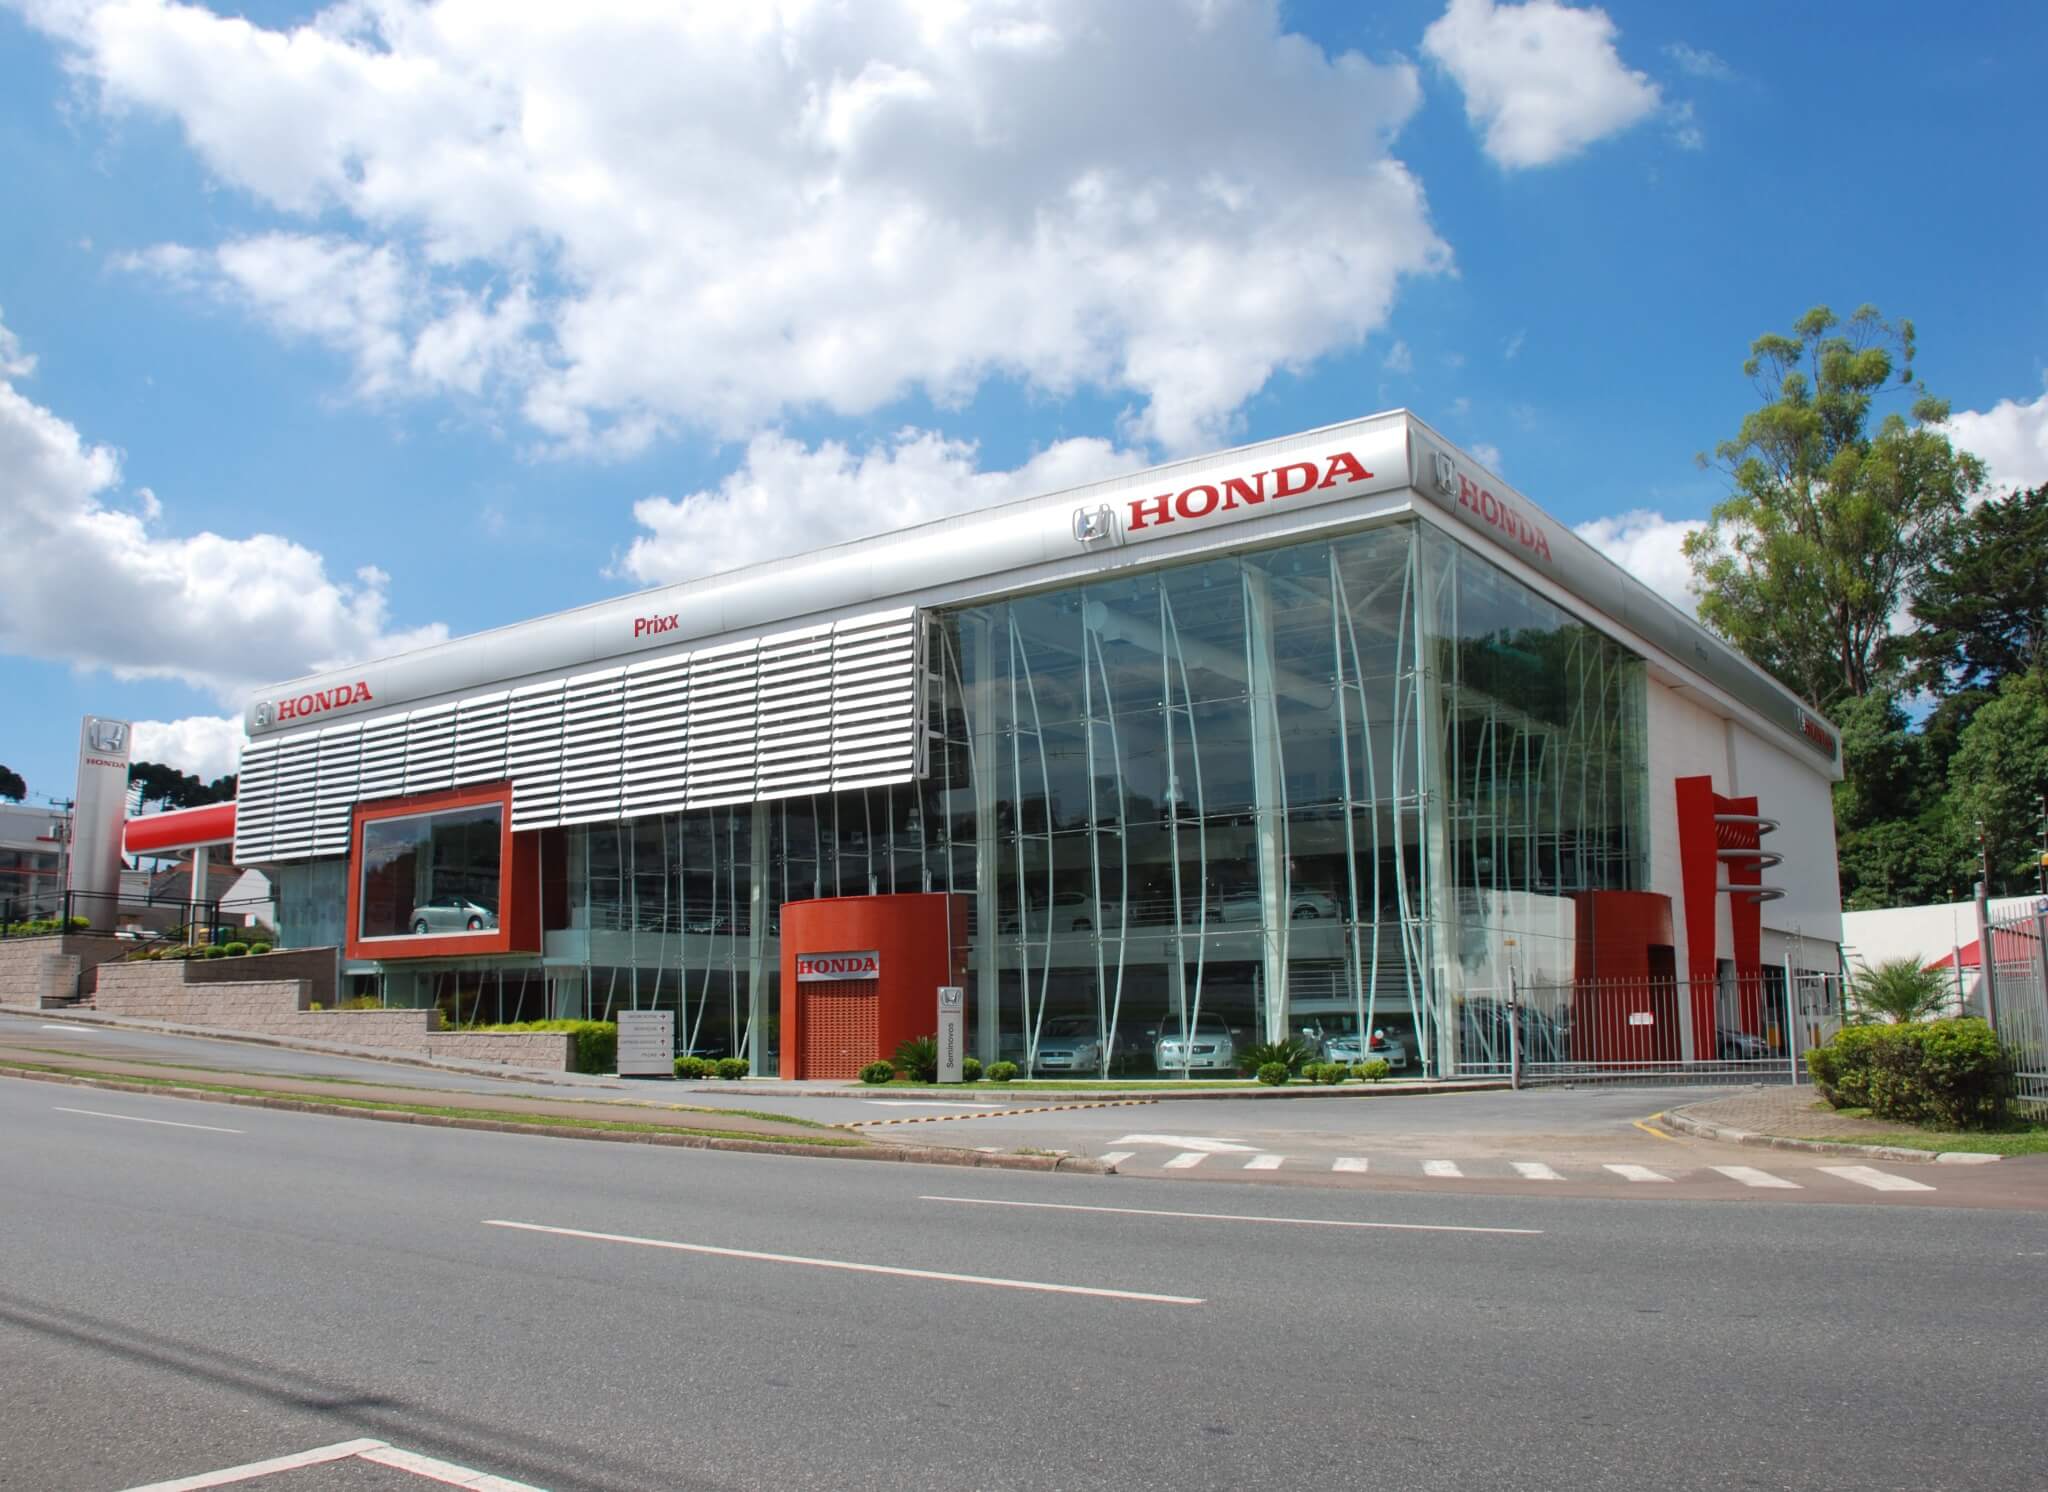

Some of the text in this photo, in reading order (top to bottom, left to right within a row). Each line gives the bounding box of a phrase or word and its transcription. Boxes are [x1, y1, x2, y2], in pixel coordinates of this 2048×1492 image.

[1127, 451, 1374, 531] HONDA
[1457, 472, 1552, 563] HONDA
[634, 614, 679, 637] Prixx
[278, 681, 373, 721] HONDA
[86, 758, 126, 769] HONDA
[799, 957, 877, 975] HONDA
[946, 1023, 954, 1069] Seminovos
